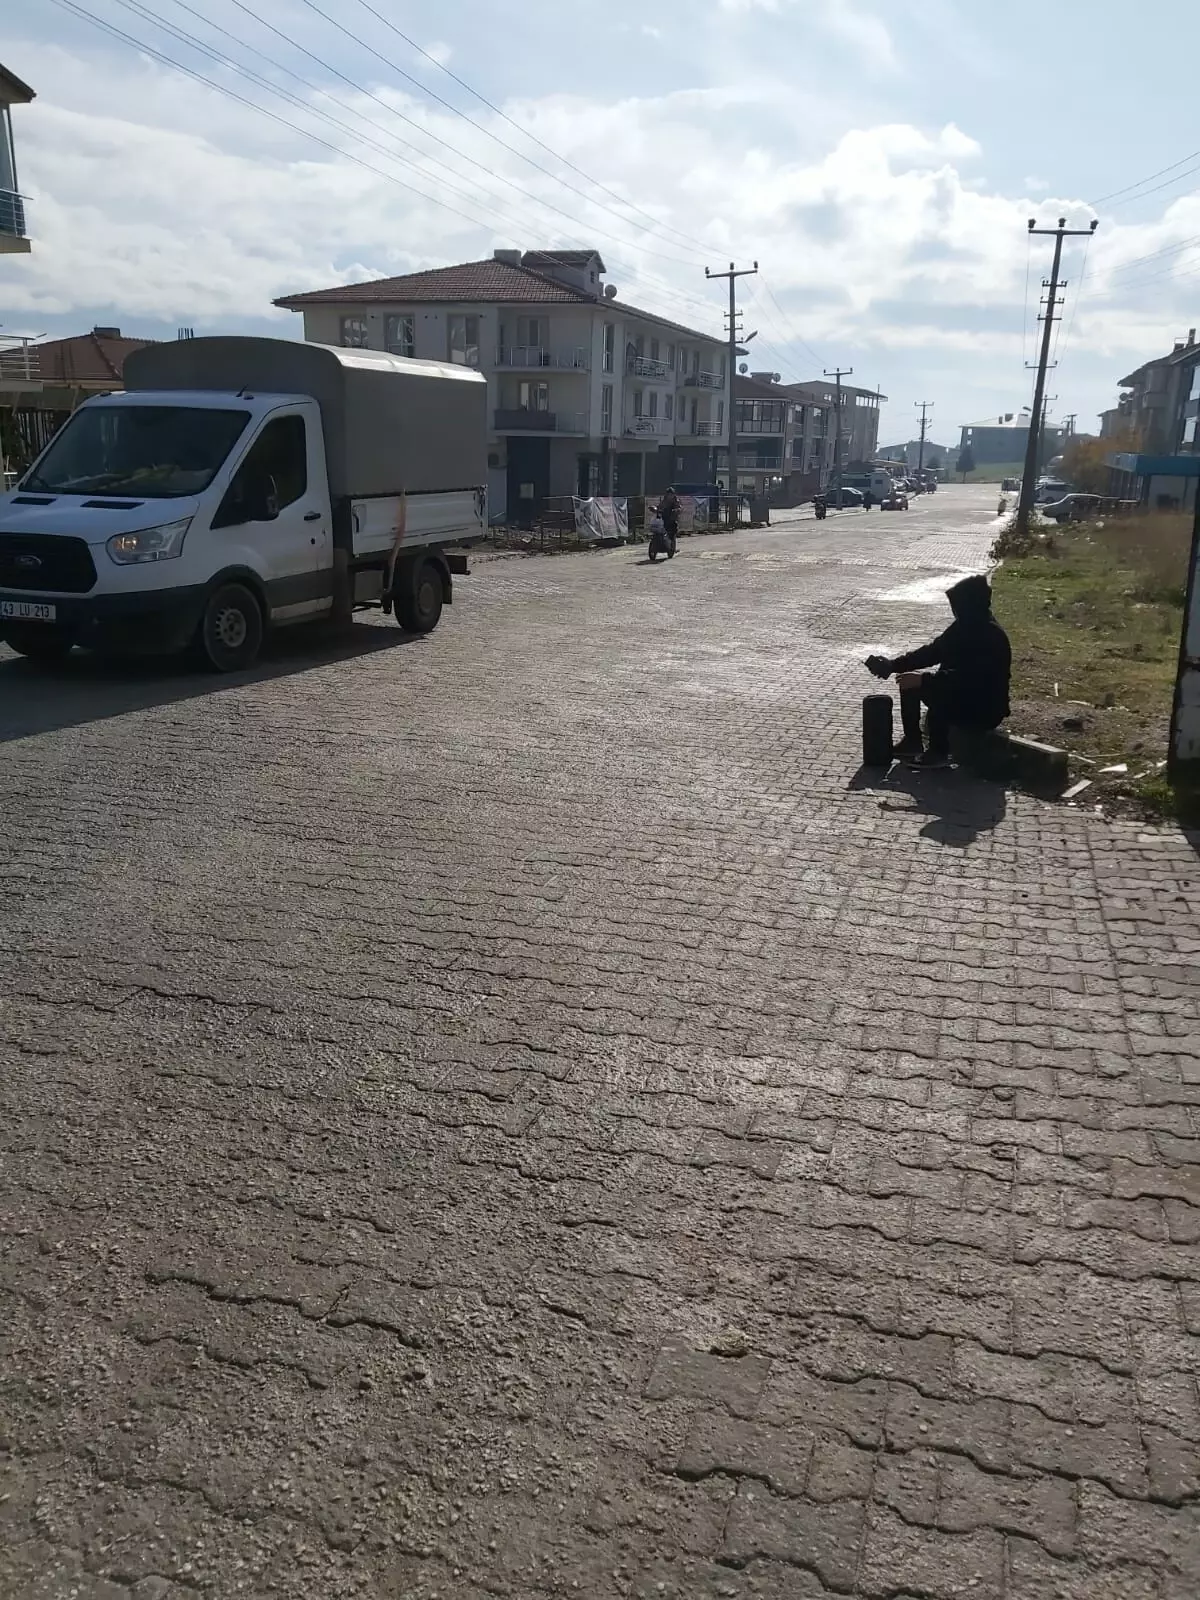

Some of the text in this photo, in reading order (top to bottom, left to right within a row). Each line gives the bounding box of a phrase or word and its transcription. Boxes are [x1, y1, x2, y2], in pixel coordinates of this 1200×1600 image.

[4, 603, 49, 617] 43 LU 213
